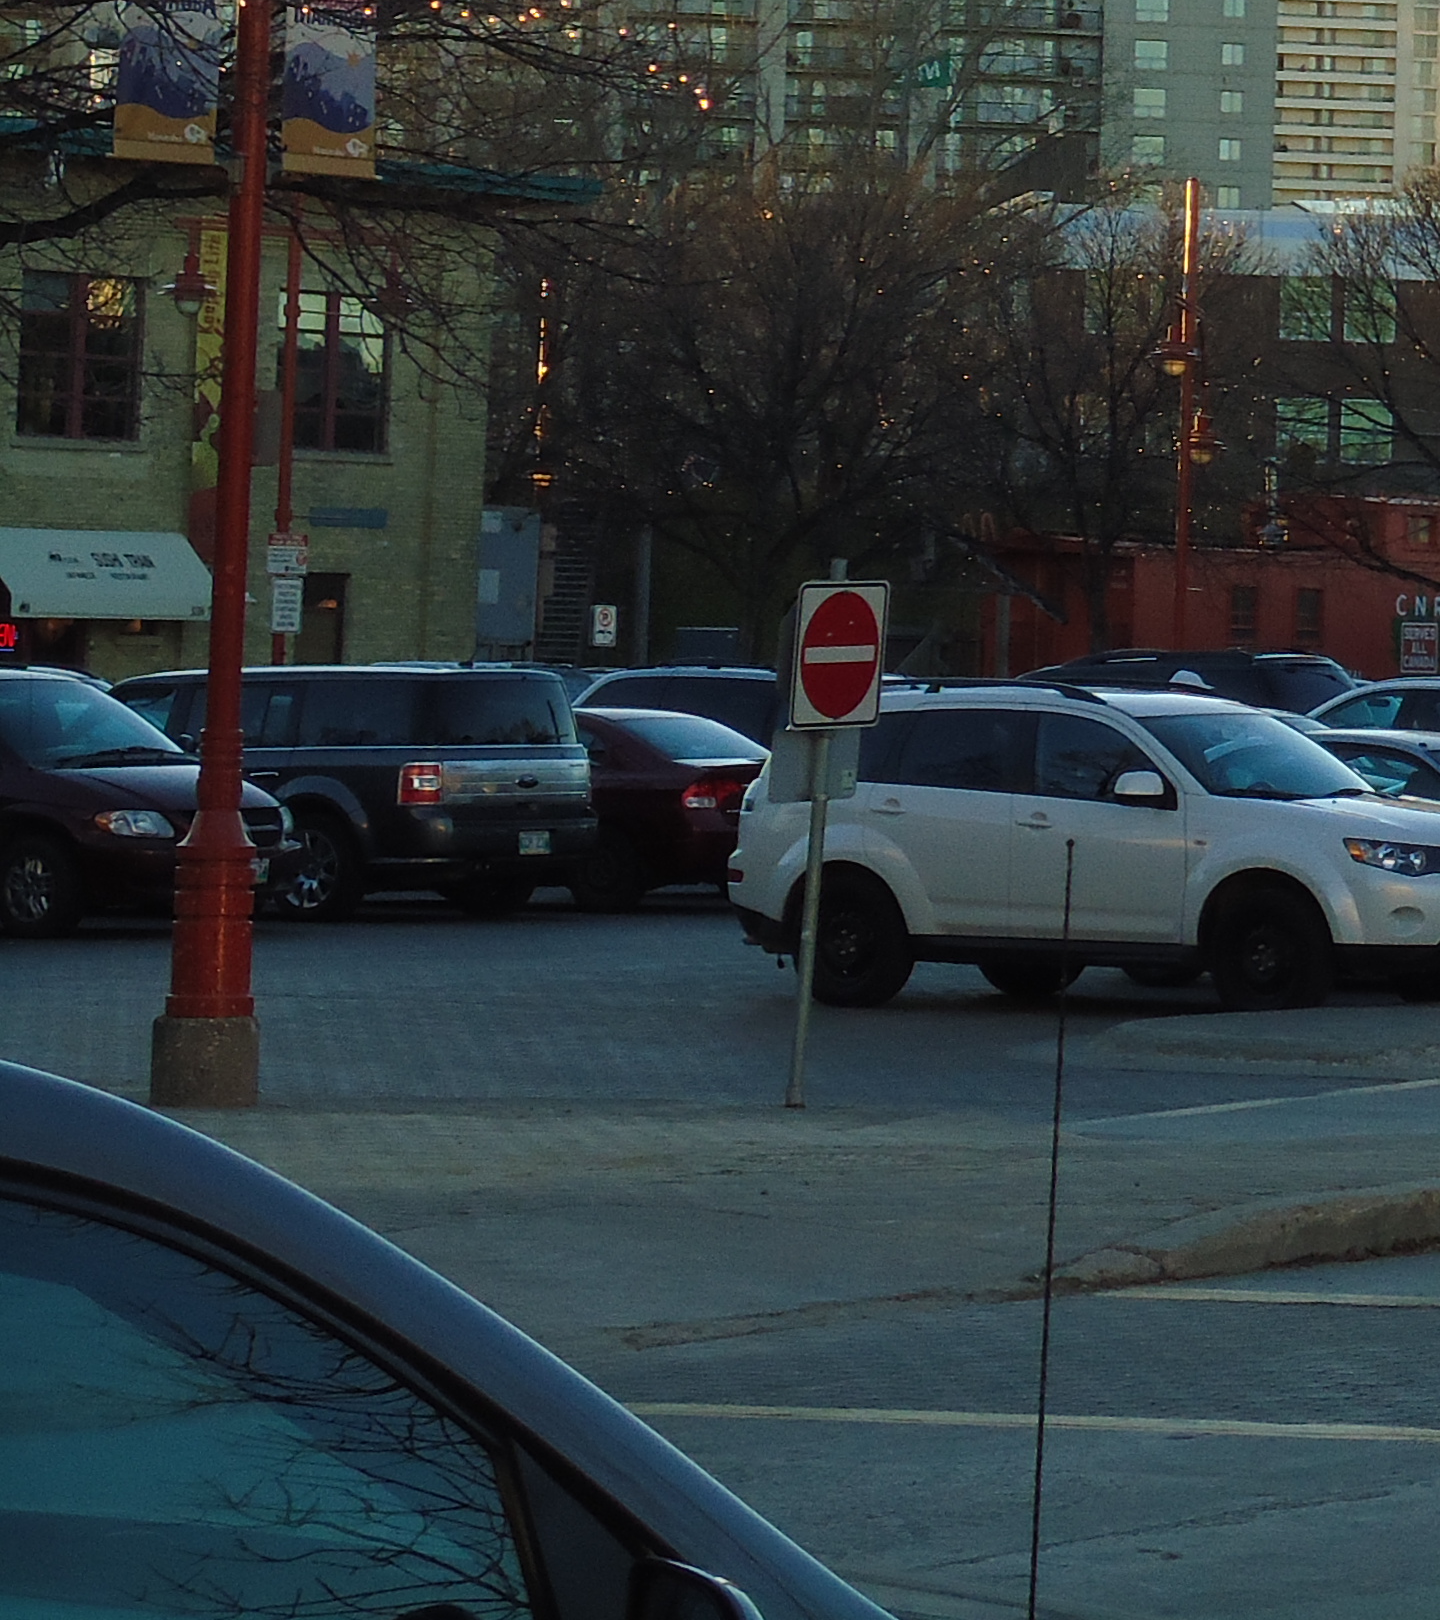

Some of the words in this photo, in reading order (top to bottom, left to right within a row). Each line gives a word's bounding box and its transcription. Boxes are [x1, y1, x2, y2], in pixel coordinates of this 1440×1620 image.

[1404, 627, 1436, 640] SERVES
[1411, 641, 1428, 654] ALL
[1404, 654, 1436, 668] CANADA
